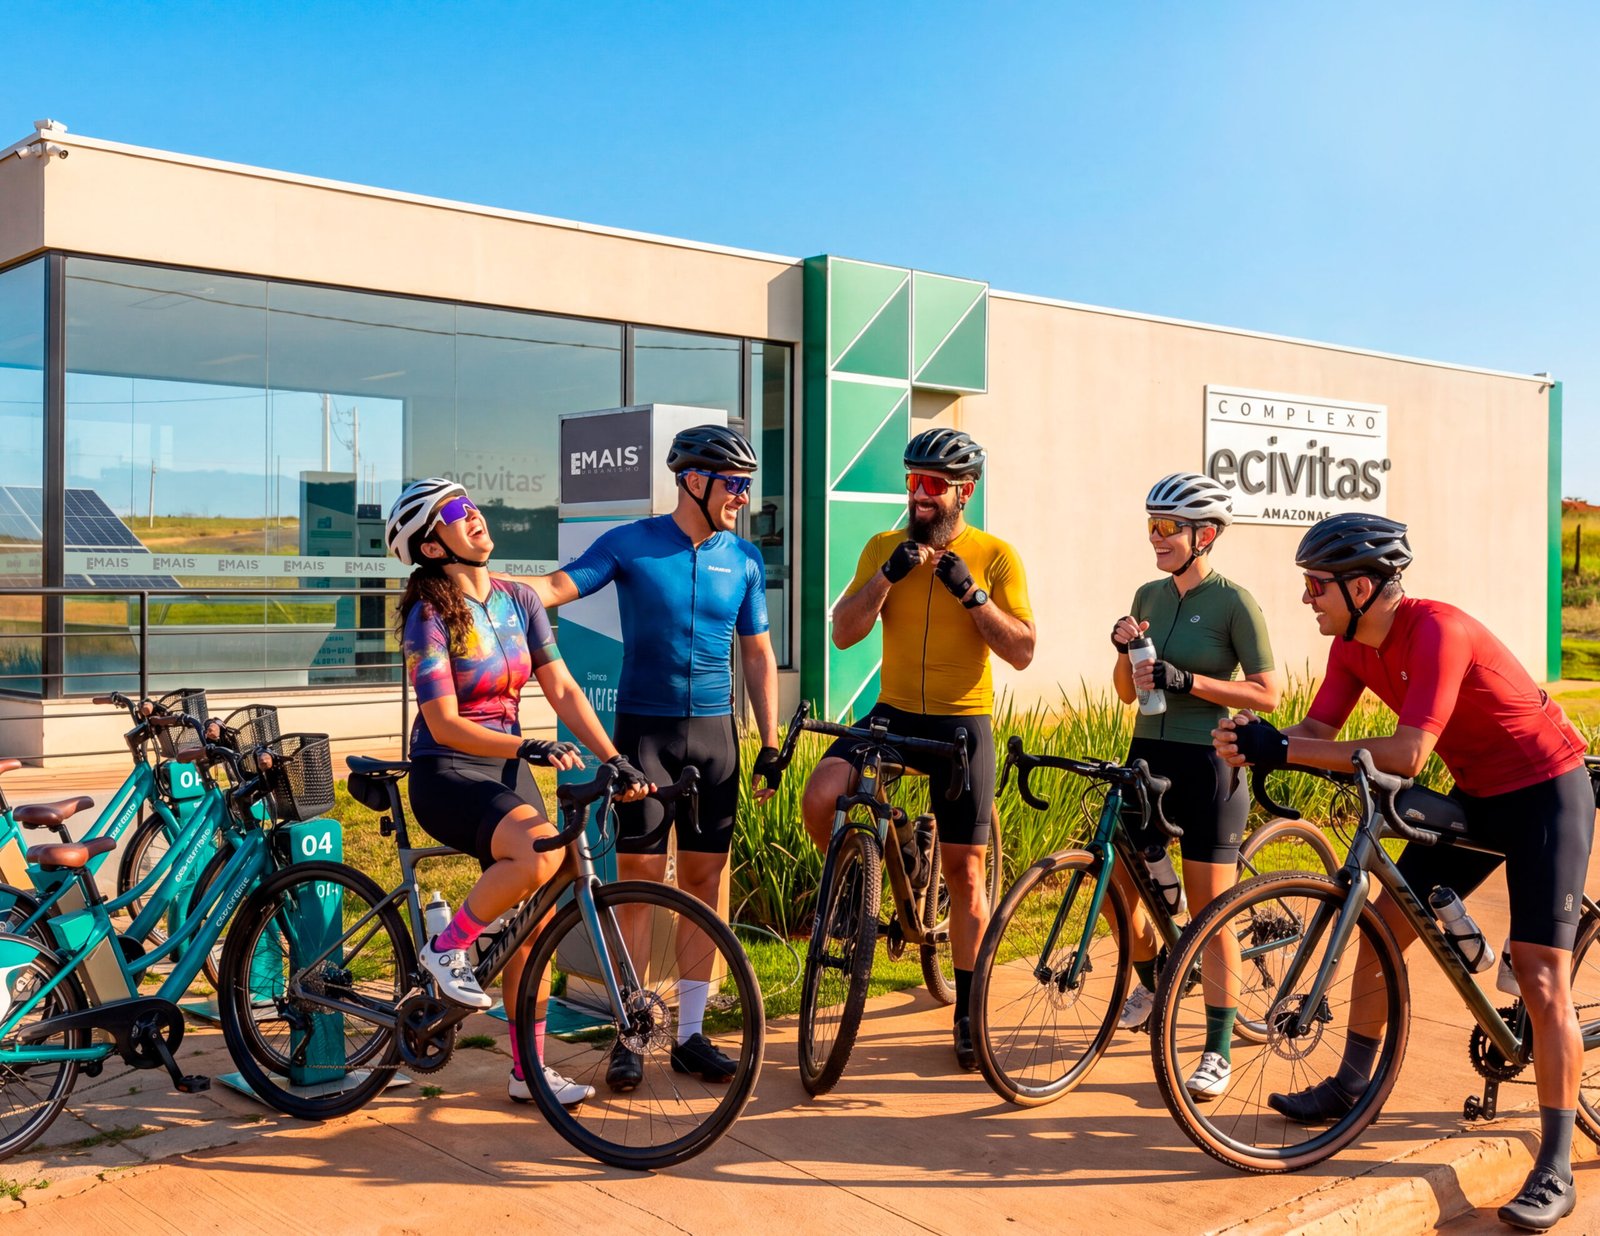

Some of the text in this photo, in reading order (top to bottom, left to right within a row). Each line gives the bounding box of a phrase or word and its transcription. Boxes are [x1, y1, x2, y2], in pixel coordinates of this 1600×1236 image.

[1218, 400, 1375, 429] COMPLEXO
[571, 446, 639, 475] EMAIS
[1209, 436, 1382, 501] ecivitas
[86, 557, 129, 570] EMAIS
[153, 558, 196, 570] EMAIS
[218, 559, 259, 571] EMAIS
[284, 560, 325, 572] EMAIS
[345, 561, 386, 573] EMAIS
[505, 563, 546, 573] EMAIS
[301, 831, 333, 856] 04
